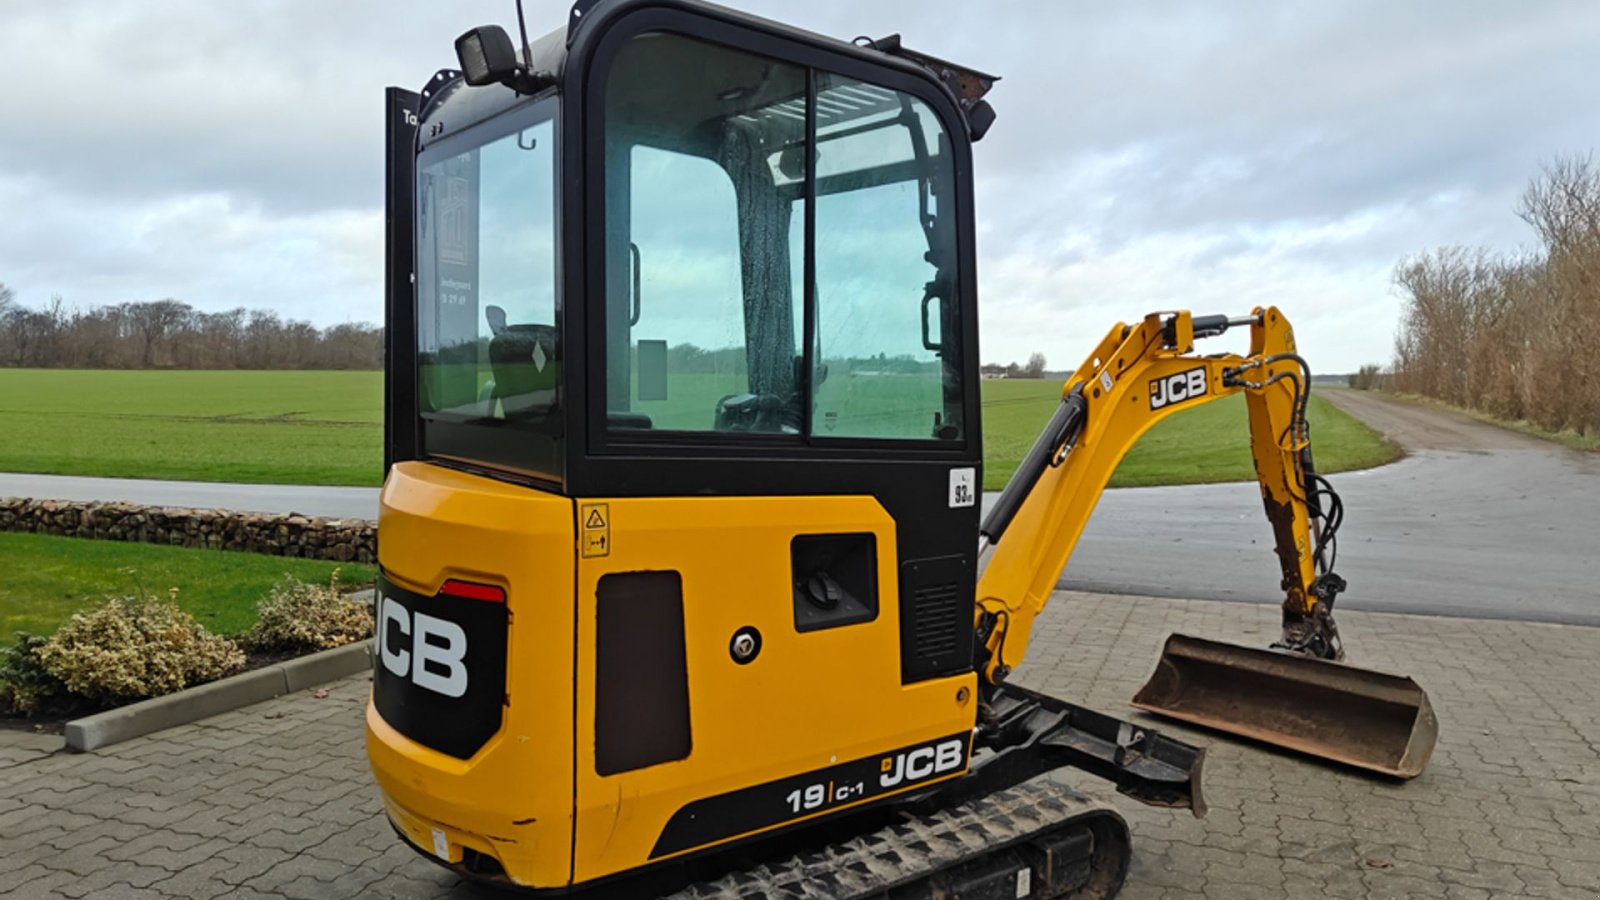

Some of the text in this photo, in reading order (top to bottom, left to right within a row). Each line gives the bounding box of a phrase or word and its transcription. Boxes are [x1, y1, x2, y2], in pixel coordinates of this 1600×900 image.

[1151, 368, 1207, 408] JCB
[786, 784, 825, 813] 19
[880, 739, 963, 788] JCB
